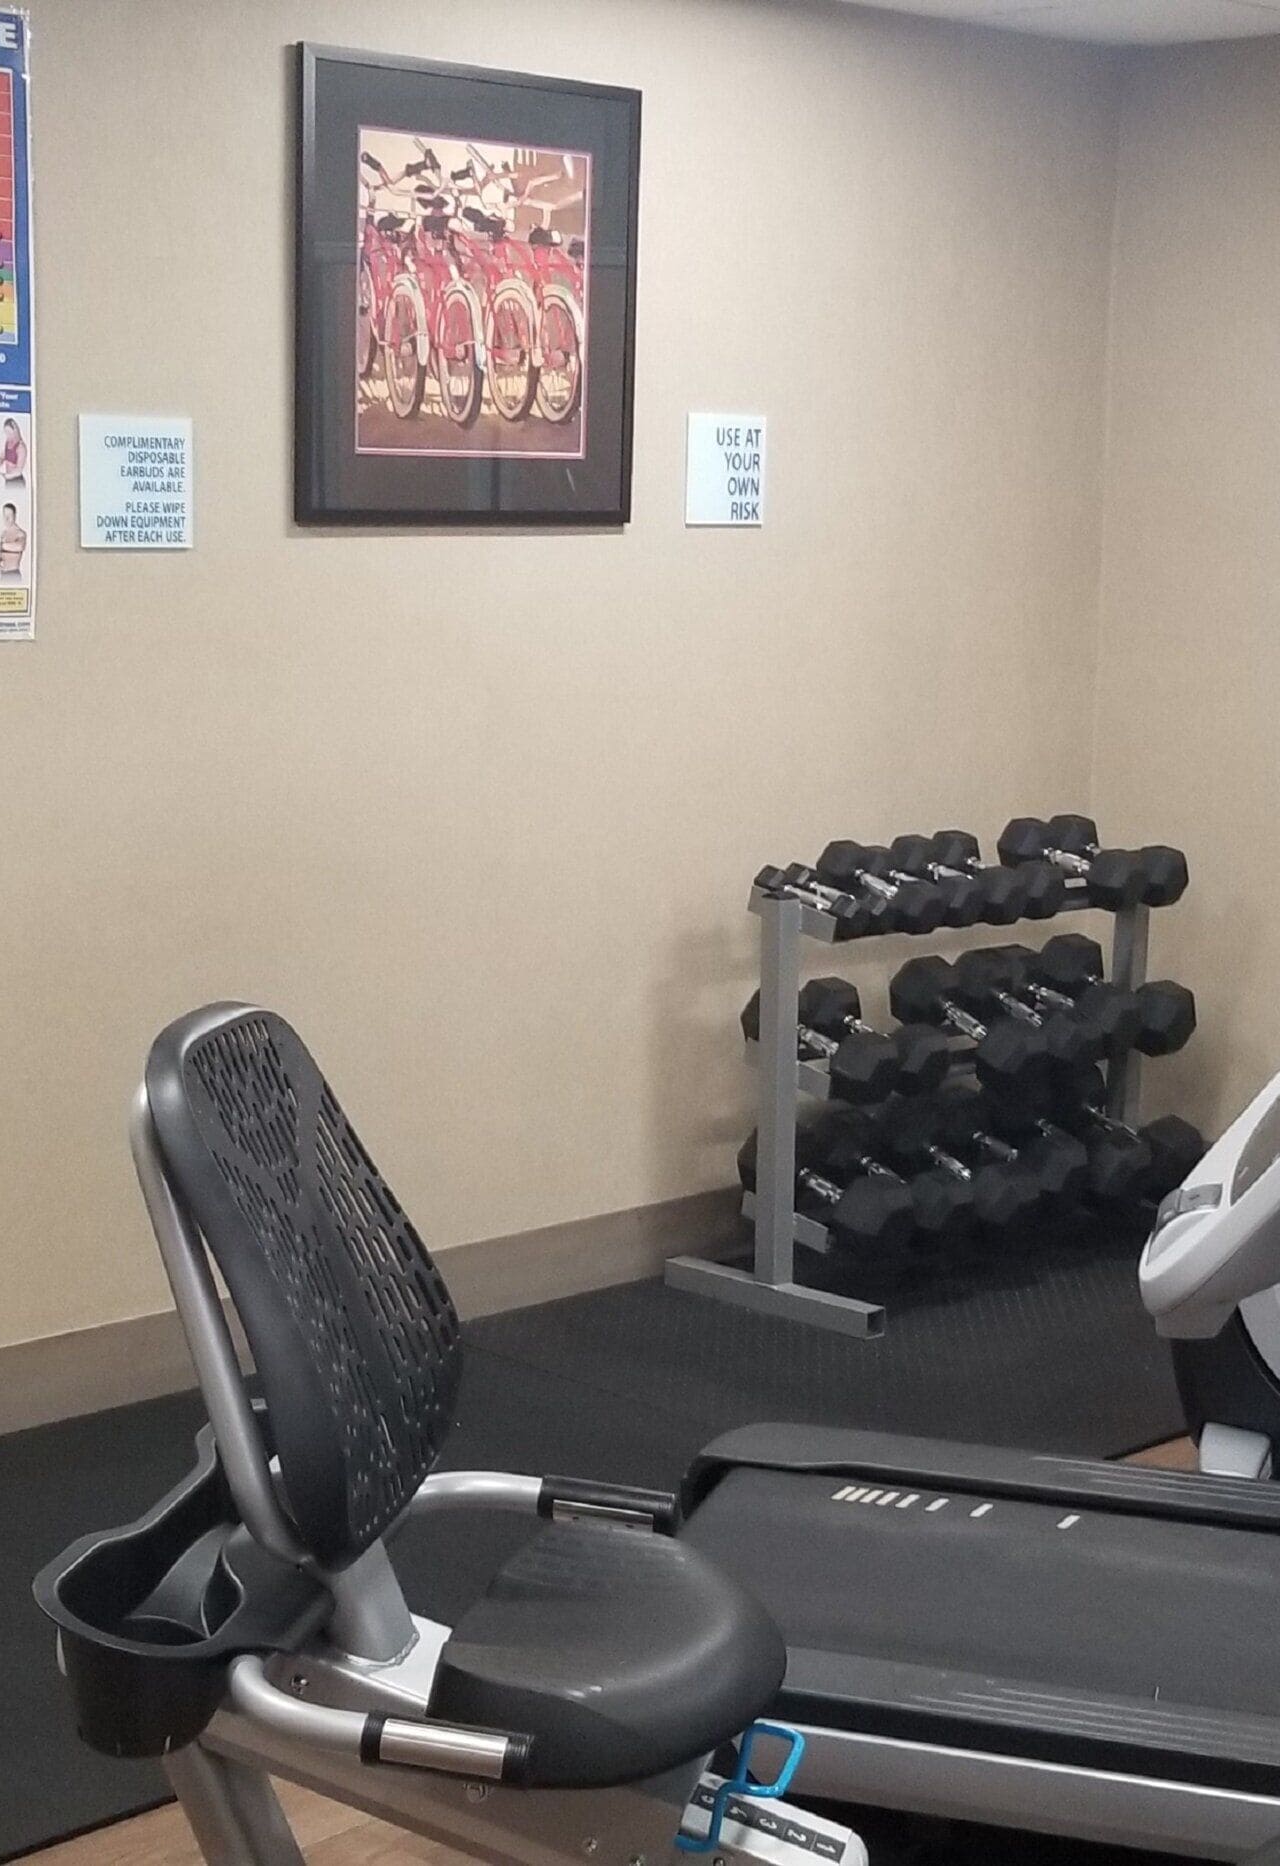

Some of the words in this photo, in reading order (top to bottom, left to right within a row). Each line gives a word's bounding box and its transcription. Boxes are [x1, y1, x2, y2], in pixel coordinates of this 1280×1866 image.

[0, 391, 18, 400] Your
[104, 435, 186, 449] COMPLIMENTARY
[716, 426, 741, 447] USE
[745, 428, 762, 447] AT
[128, 451, 185, 464] DISPOSABLE
[724, 452, 761, 472] YOUR
[120, 465, 164, 478] EARBUDS
[167, 467, 185, 478] ARE
[132, 481, 186, 493] AVAILABLE.
[727, 477, 760, 496] OWN
[125, 501, 160, 514] PLEASE
[162, 502, 186, 514] WIPE
[730, 501, 760, 521] RISK
[96, 515, 128, 528] DOWN
[130, 516, 186, 529] EQUIPMENT
[105, 530, 135, 542] AFTER
[137, 531, 162, 543] EACH
[166, 530, 186, 543] USE.
[759, 1817, 778, 1830] 3
[787, 1828, 808, 1843] 2
[816, 1841, 837, 1855] 1
